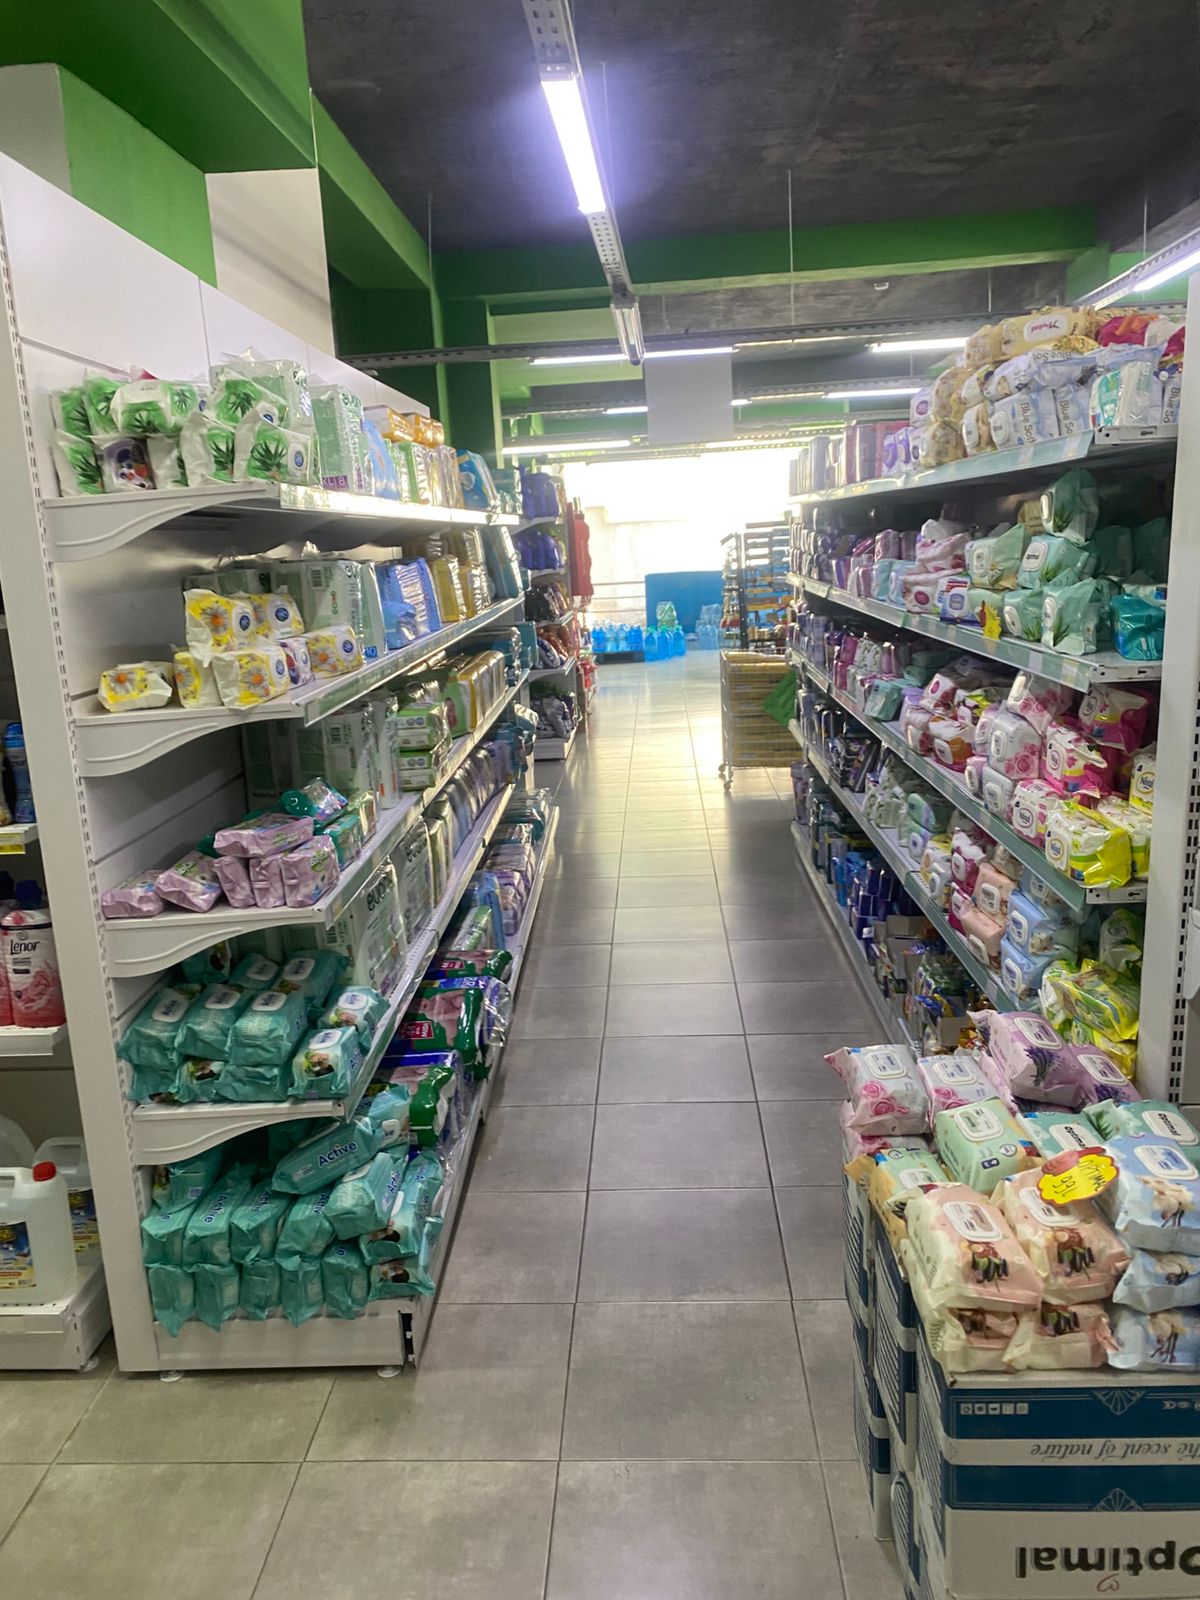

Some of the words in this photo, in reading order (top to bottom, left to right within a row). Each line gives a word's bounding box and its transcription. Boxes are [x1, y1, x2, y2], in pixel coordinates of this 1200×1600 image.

[1020, 403, 1030, 424] Blue
[10, 939, 41, 956] Lenor
[1158, 1113, 1182, 1137] Optimal
[1063, 1126, 1087, 1149] Optima
[317, 1141, 358, 1168] Active
[1030, 1442, 1093, 1462] nature
[1123, 1440, 1172, 1460] scent
[1016, 1540, 1200, 1579] Optimal
